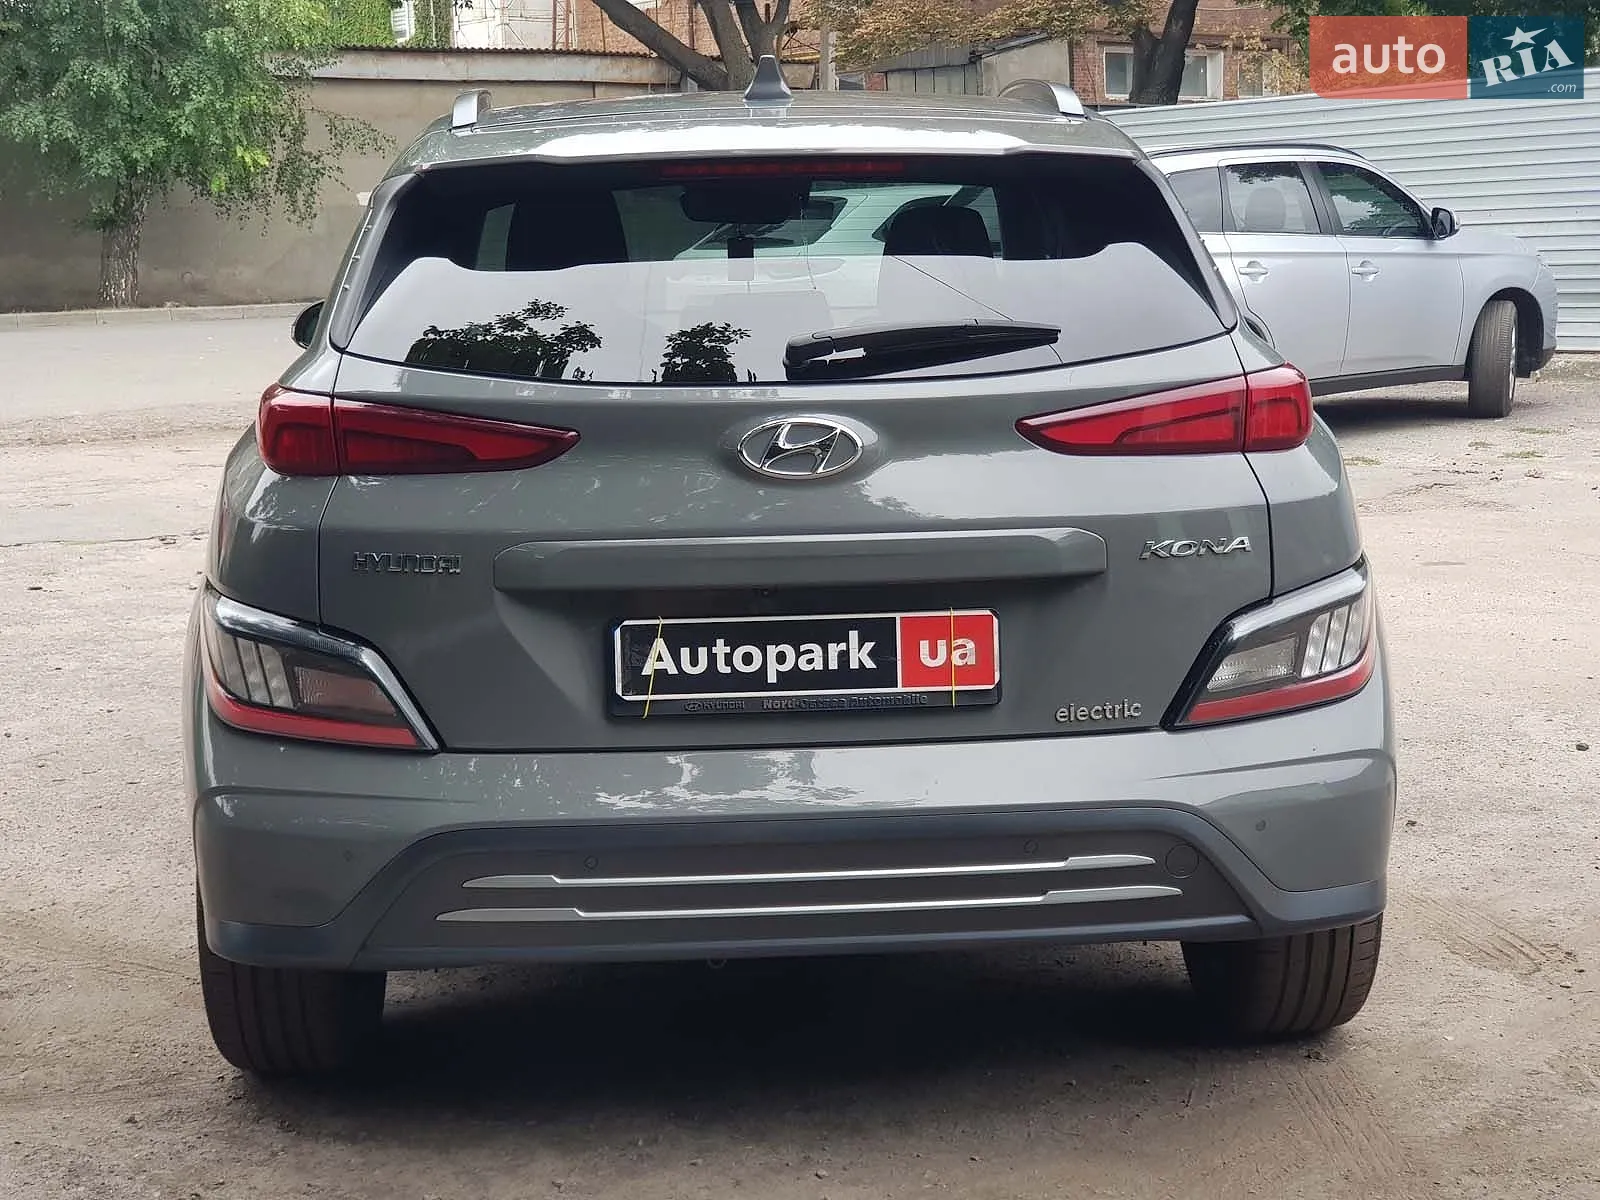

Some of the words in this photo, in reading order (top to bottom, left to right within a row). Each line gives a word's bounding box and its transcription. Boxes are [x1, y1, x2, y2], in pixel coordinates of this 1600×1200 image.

[1139, 536, 1252, 560] KONA
[353, 552, 462, 574] HYUNDAI
[641, 630, 877, 683] Autopark
[919, 638, 976, 668] ua
[1055, 698, 1142, 722] electric
